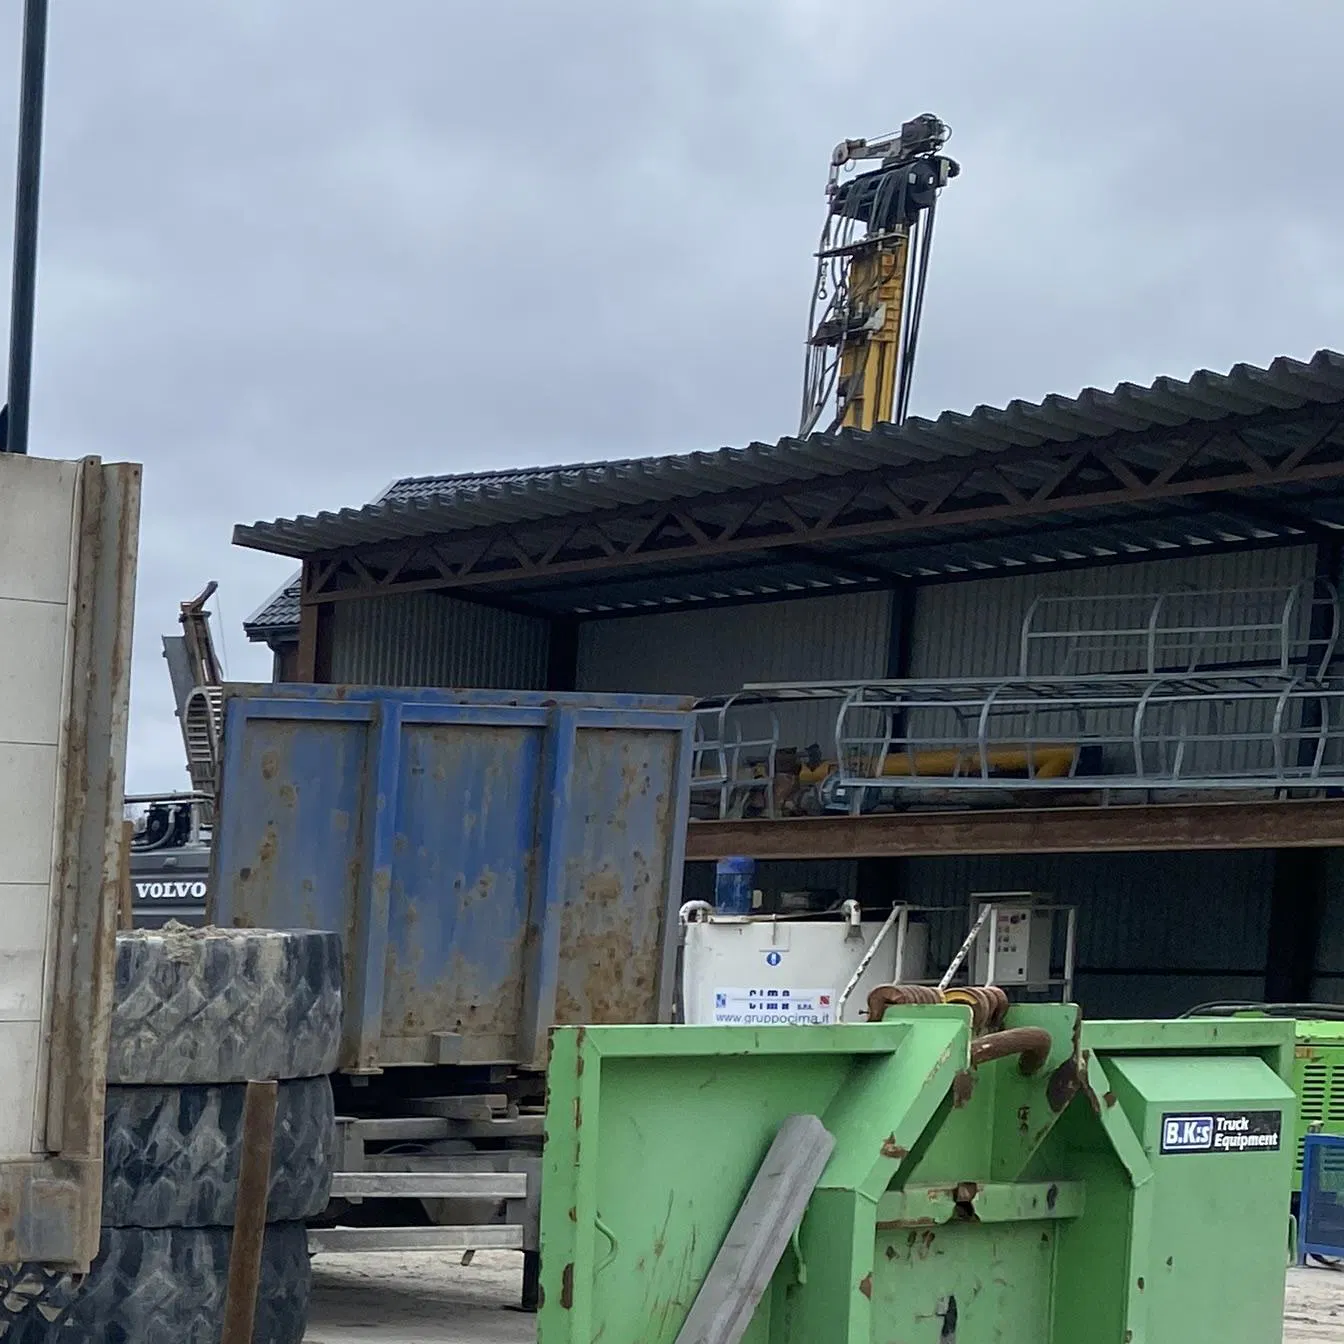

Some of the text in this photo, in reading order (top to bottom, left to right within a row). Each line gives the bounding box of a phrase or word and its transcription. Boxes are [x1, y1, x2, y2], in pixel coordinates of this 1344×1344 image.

[135, 882, 207, 898] VOLVO
[715, 1012, 830, 1025] www.gruppocima.it
[1215, 1117, 1250, 1131] Truck
[1214, 1132, 1279, 1151] Equipment
